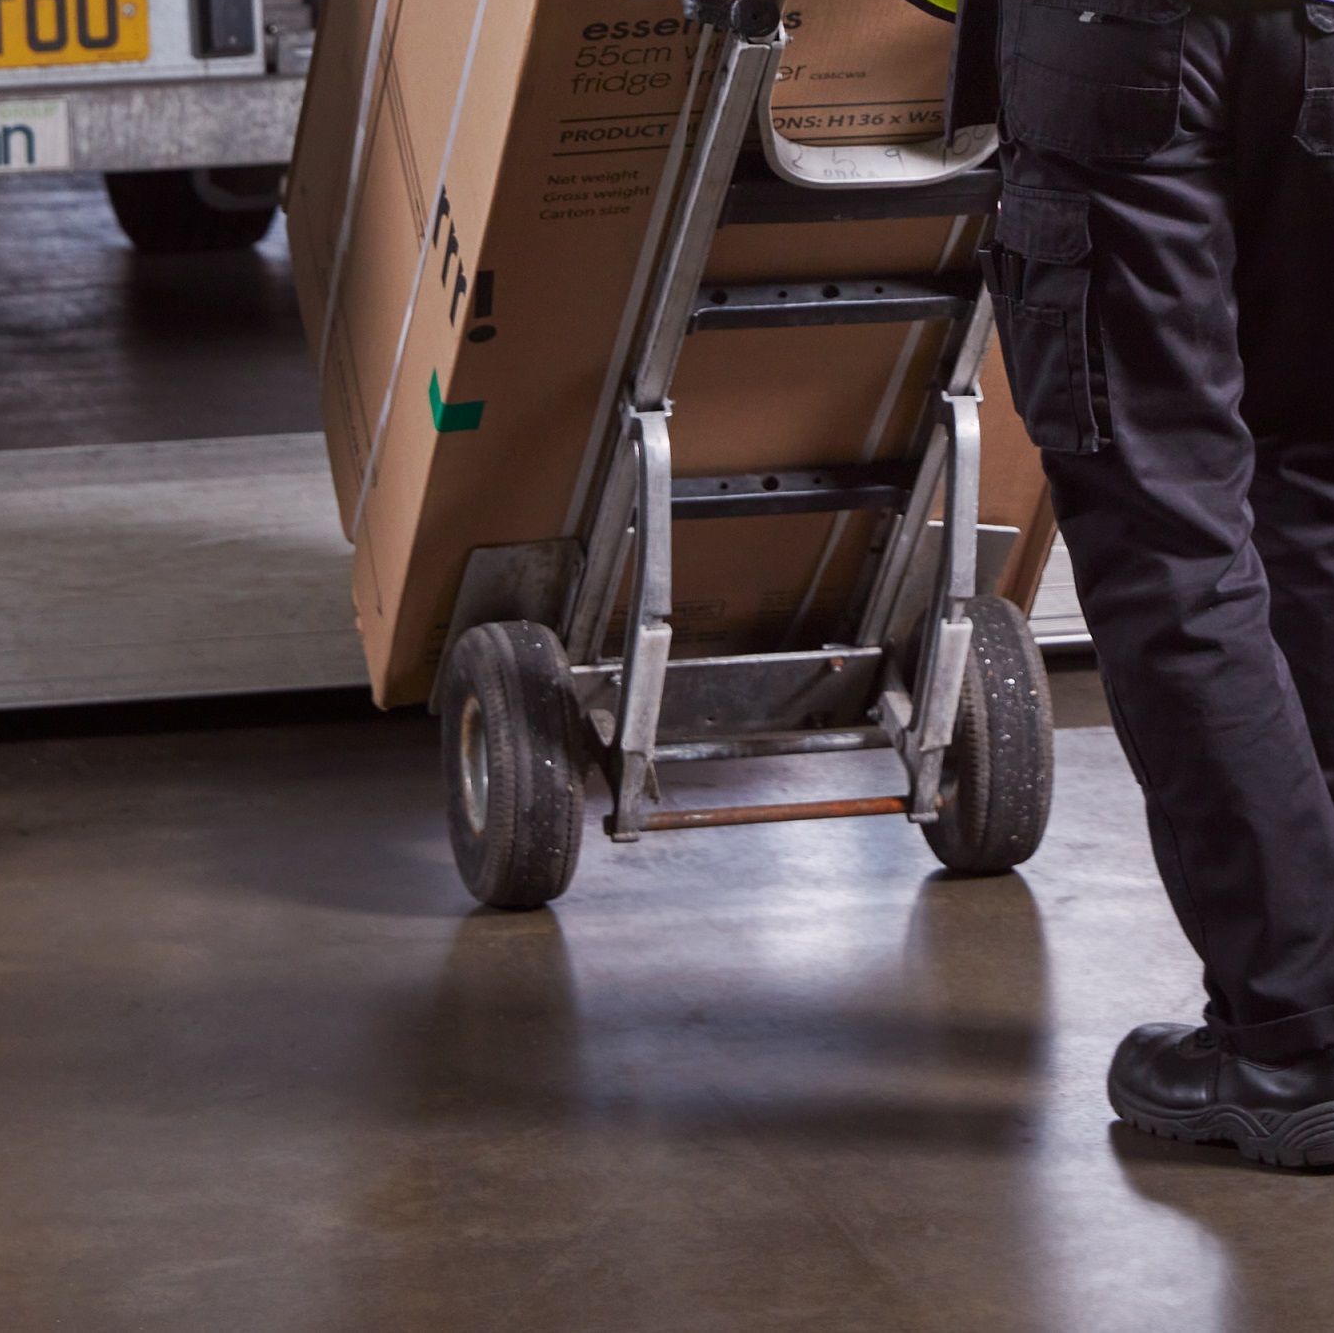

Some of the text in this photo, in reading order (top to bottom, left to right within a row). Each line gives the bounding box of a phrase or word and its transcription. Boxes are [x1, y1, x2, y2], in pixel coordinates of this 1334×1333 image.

[575, 45, 672, 68] 55cm
[571, 70, 672, 96] fridge
[560, 124, 667, 144] PRODUCT
[828, 113, 883, 128] H136
[547, 170, 639, 185] Net weight
[543, 186, 650, 203] Gross weight
[539, 204, 631, 220] Carton size
